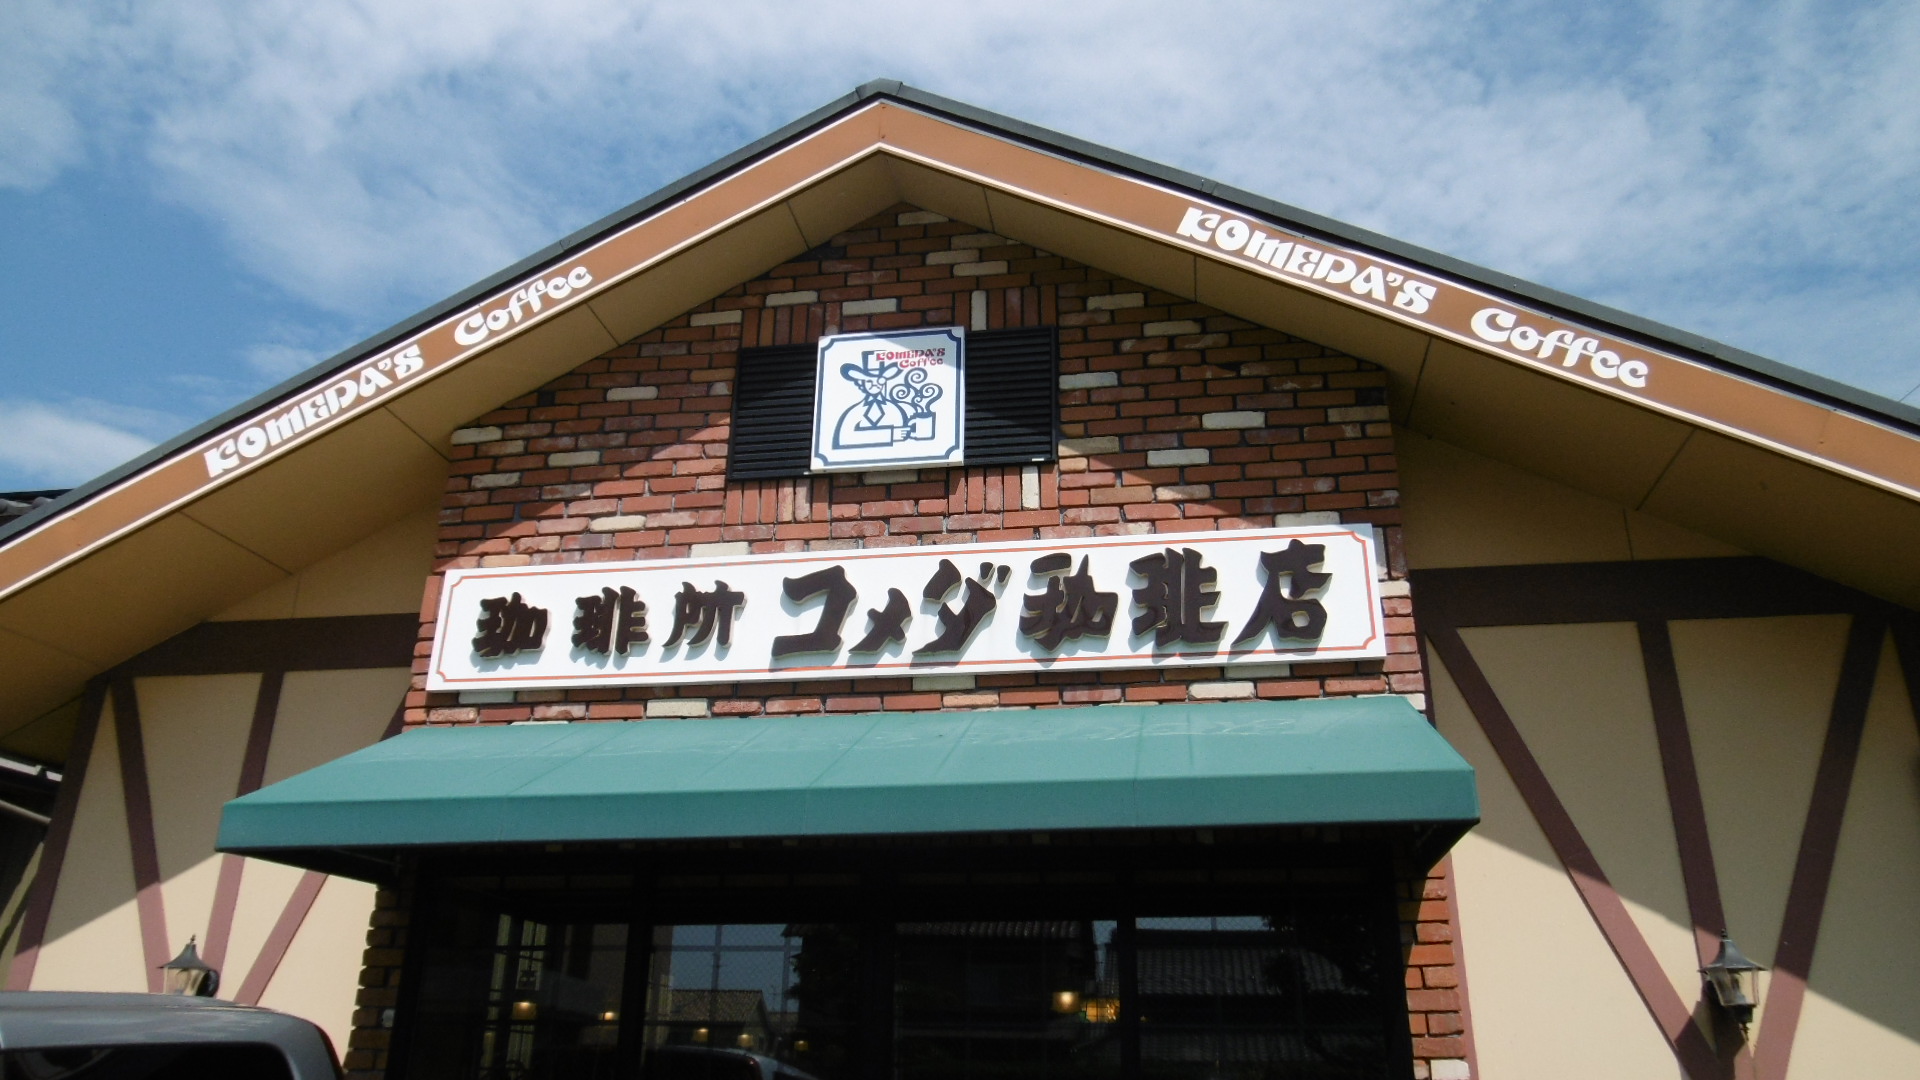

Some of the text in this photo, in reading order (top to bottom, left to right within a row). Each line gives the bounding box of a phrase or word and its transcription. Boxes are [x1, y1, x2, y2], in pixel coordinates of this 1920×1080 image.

[453, 265, 593, 346] Coffee
[899, 357, 944, 369] Coffee
[1470, 307, 1649, 388] Coffee
[471, 579, 748, 658] 珈琲所
